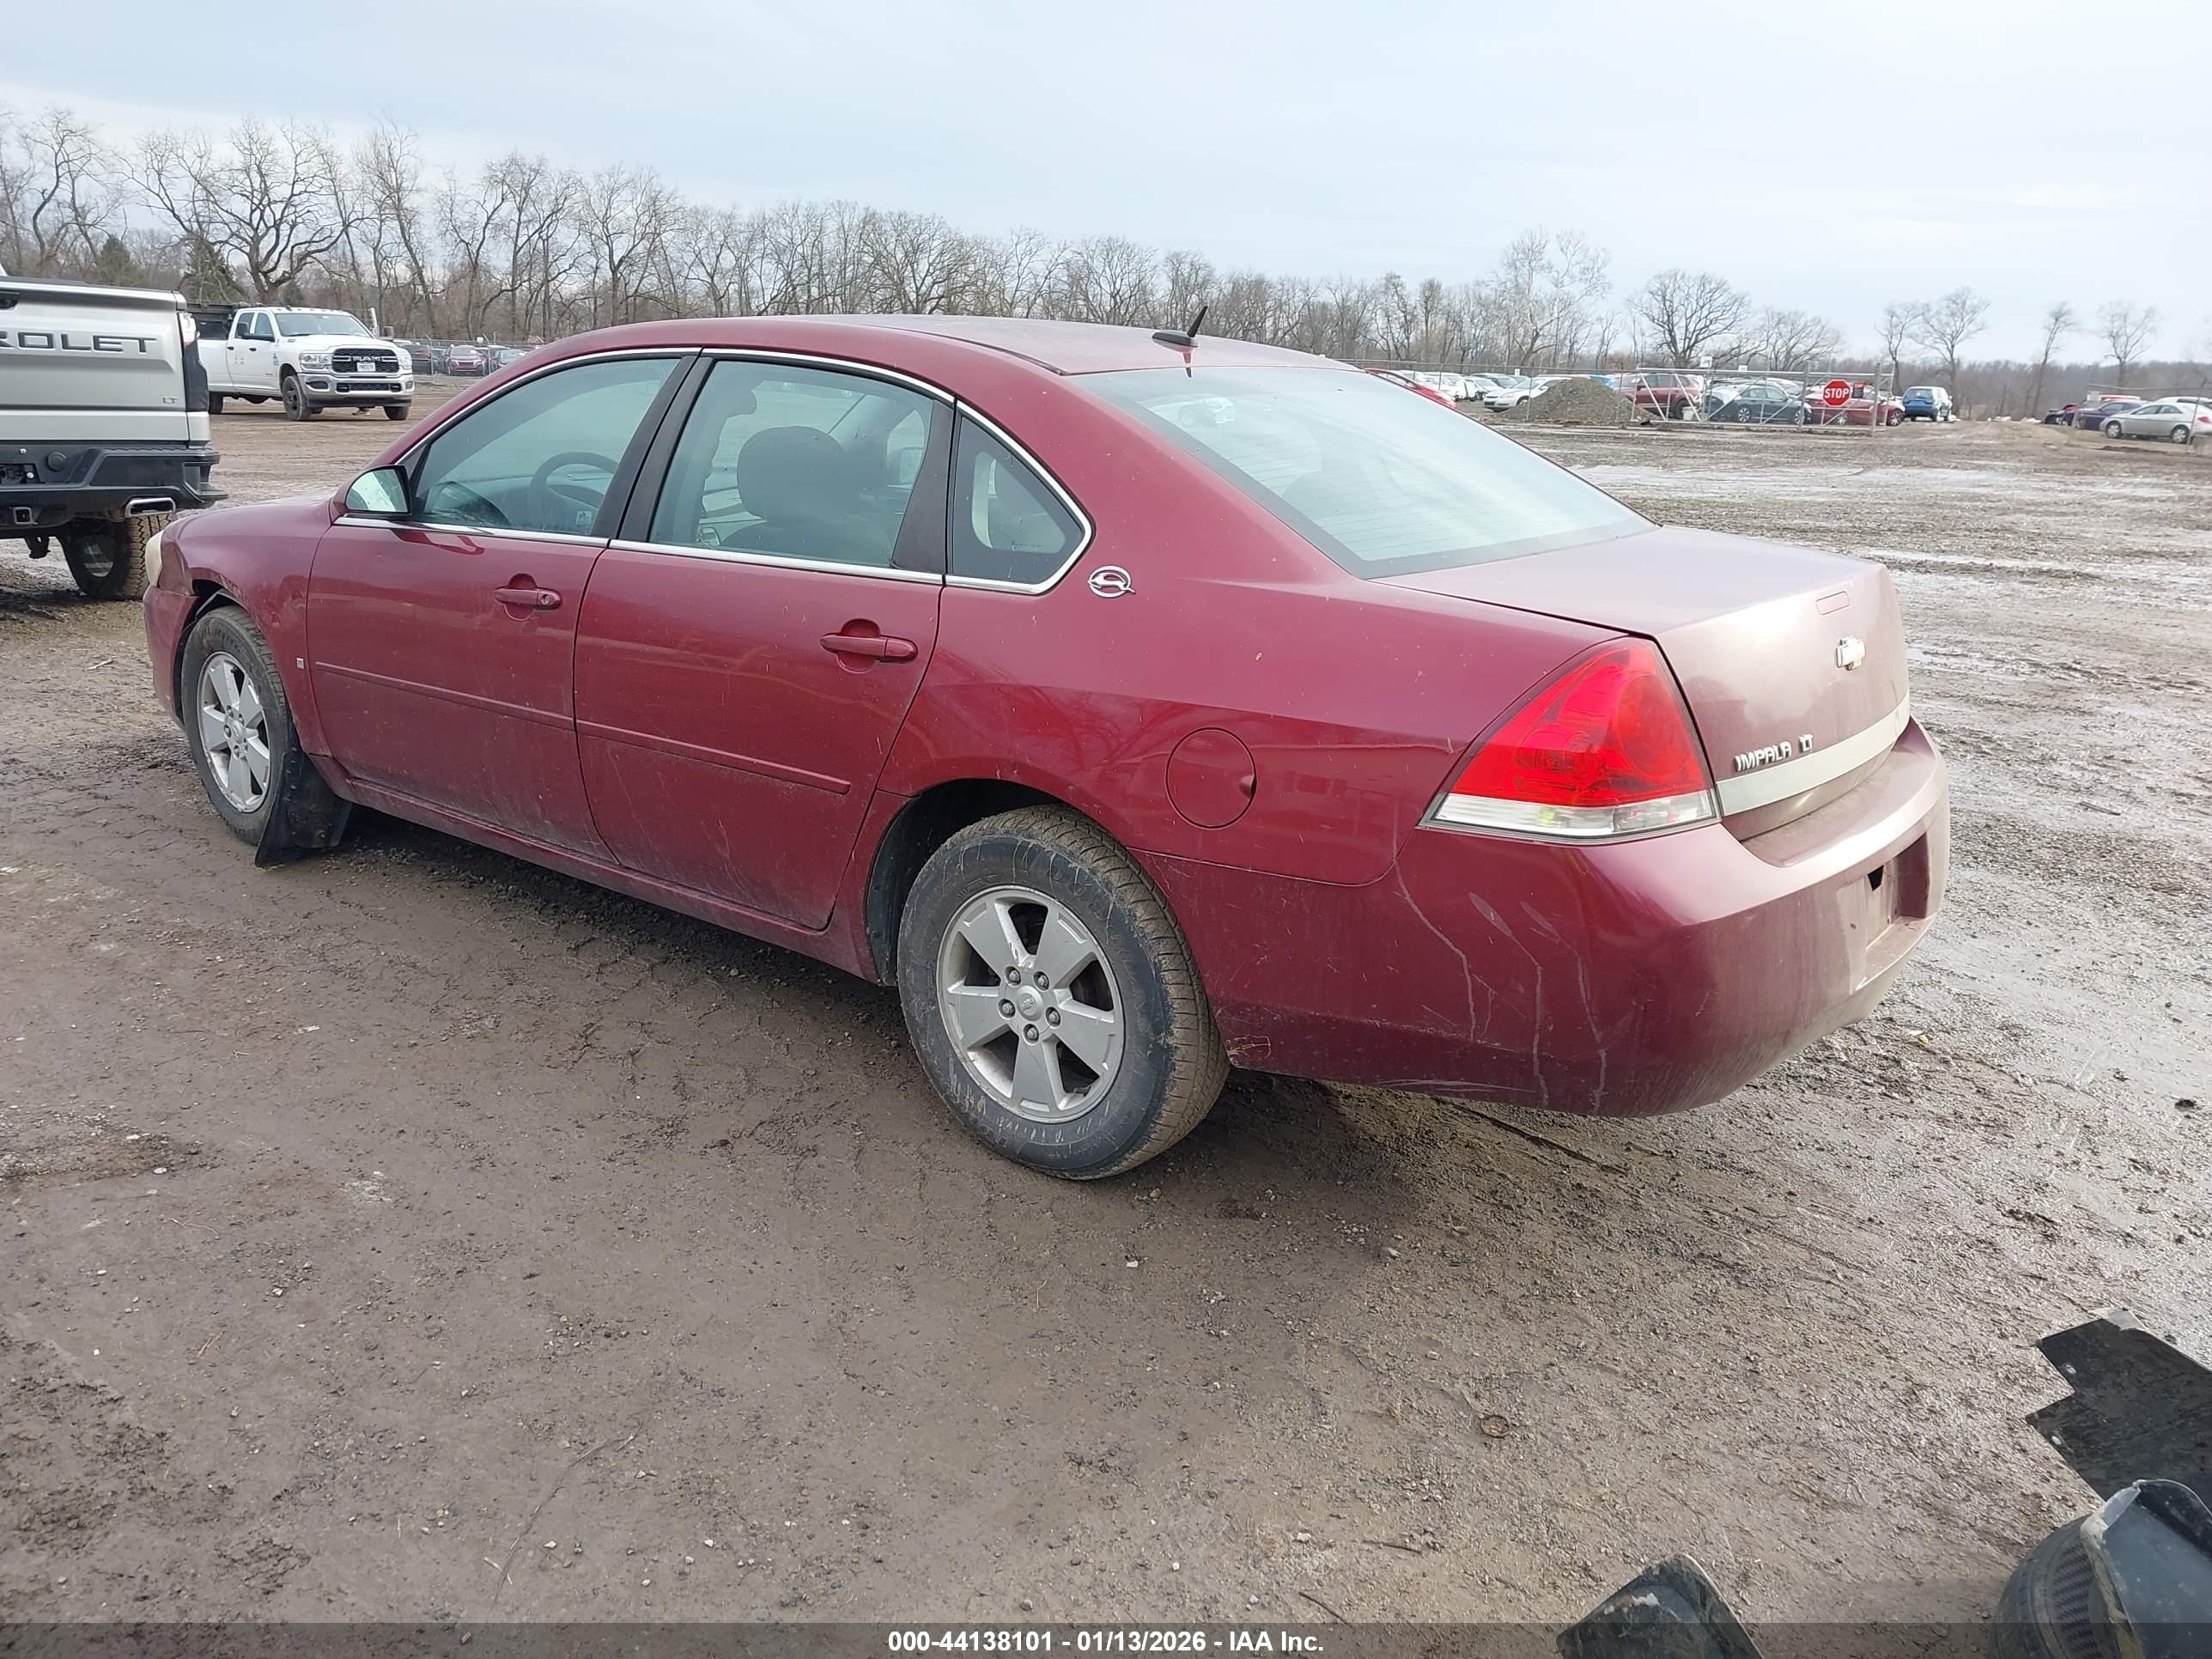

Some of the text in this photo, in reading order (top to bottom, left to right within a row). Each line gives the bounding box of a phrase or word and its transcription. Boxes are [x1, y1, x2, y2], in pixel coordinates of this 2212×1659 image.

[1824, 387, 1849, 398] STOP
[1734, 733, 1814, 771] IMPALA LT
